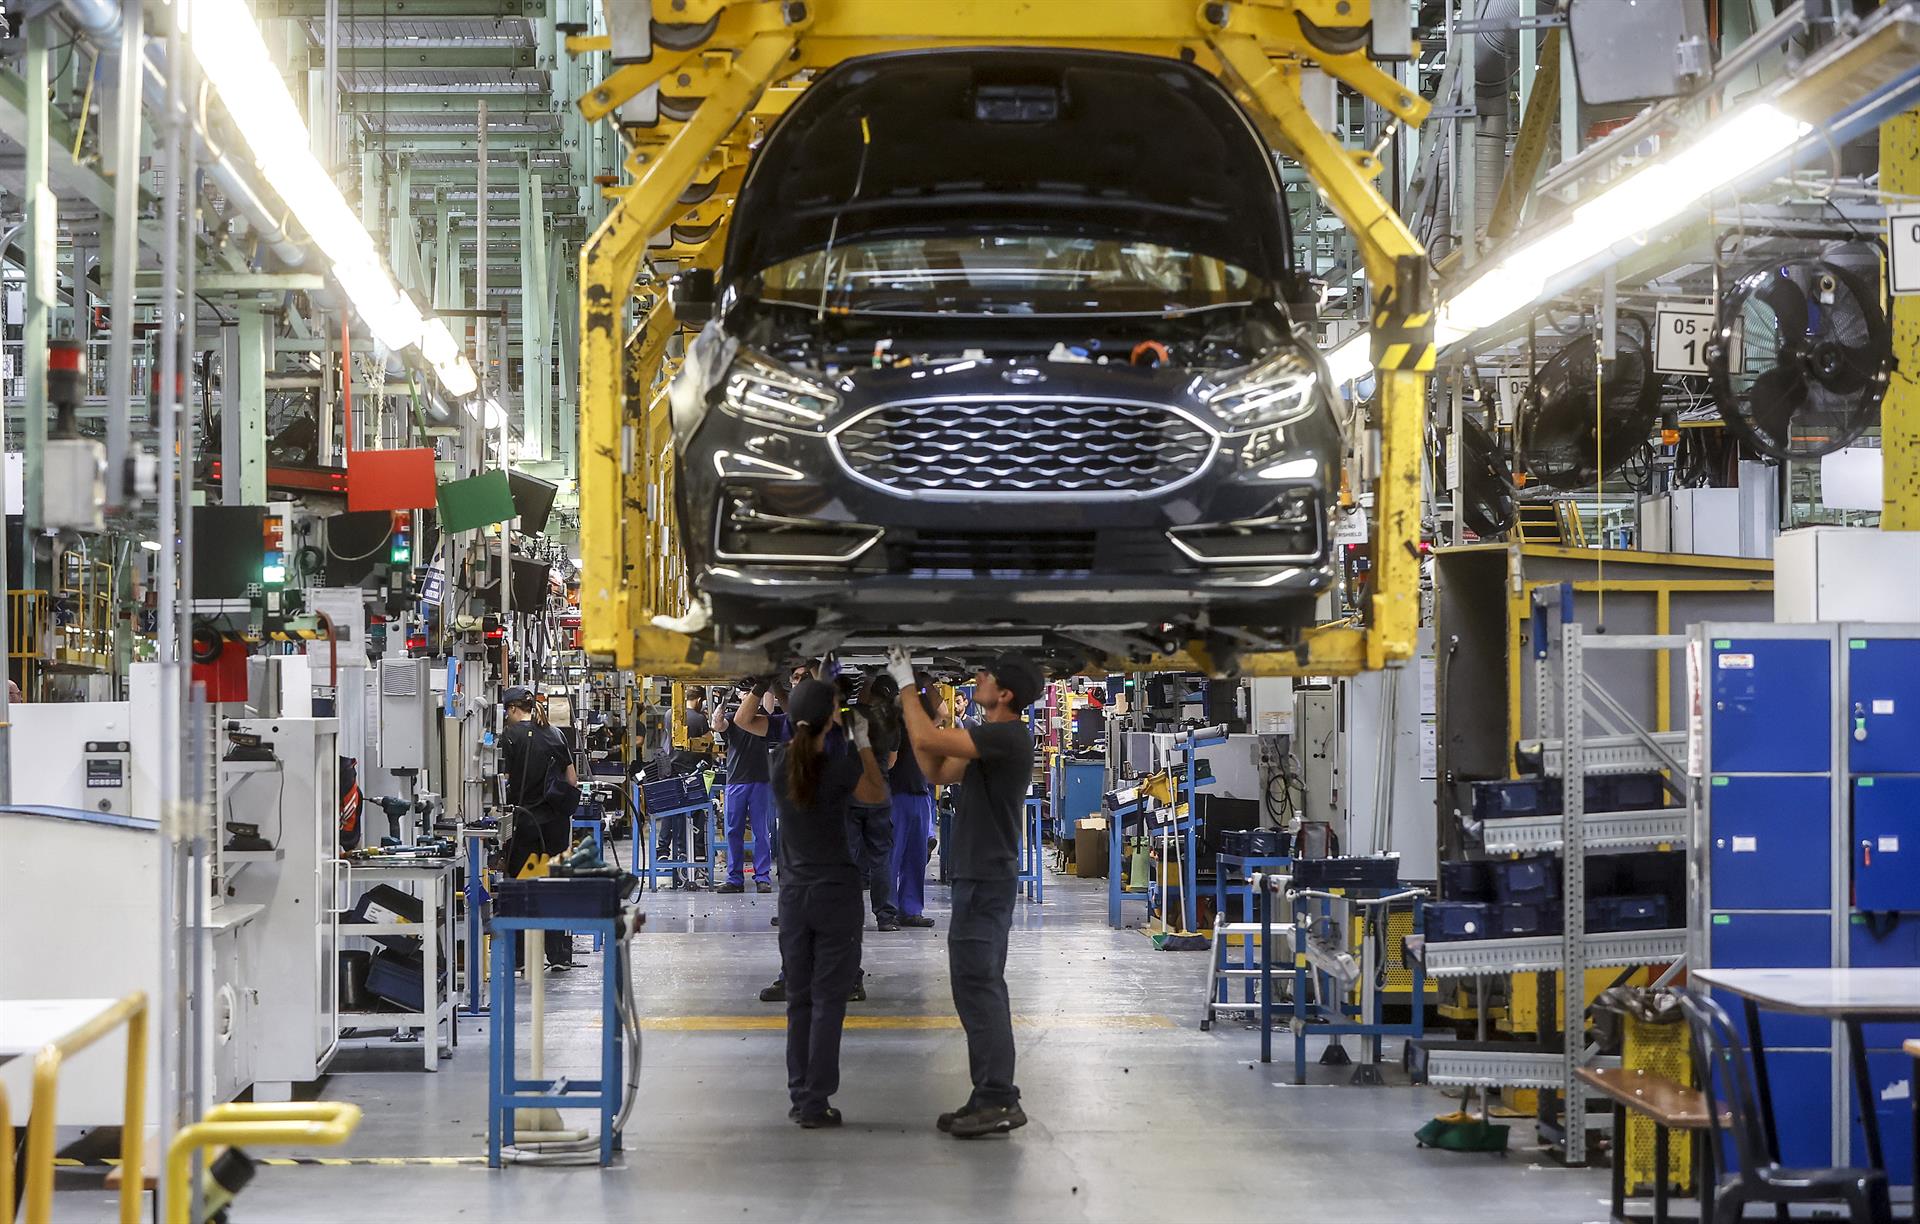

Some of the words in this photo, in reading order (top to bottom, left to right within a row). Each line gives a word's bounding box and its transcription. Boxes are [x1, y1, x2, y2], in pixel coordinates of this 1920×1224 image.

[1674, 318, 1696, 335] 05
[148, 609, 155, 619] K
[148, 621, 154, 631] 7
